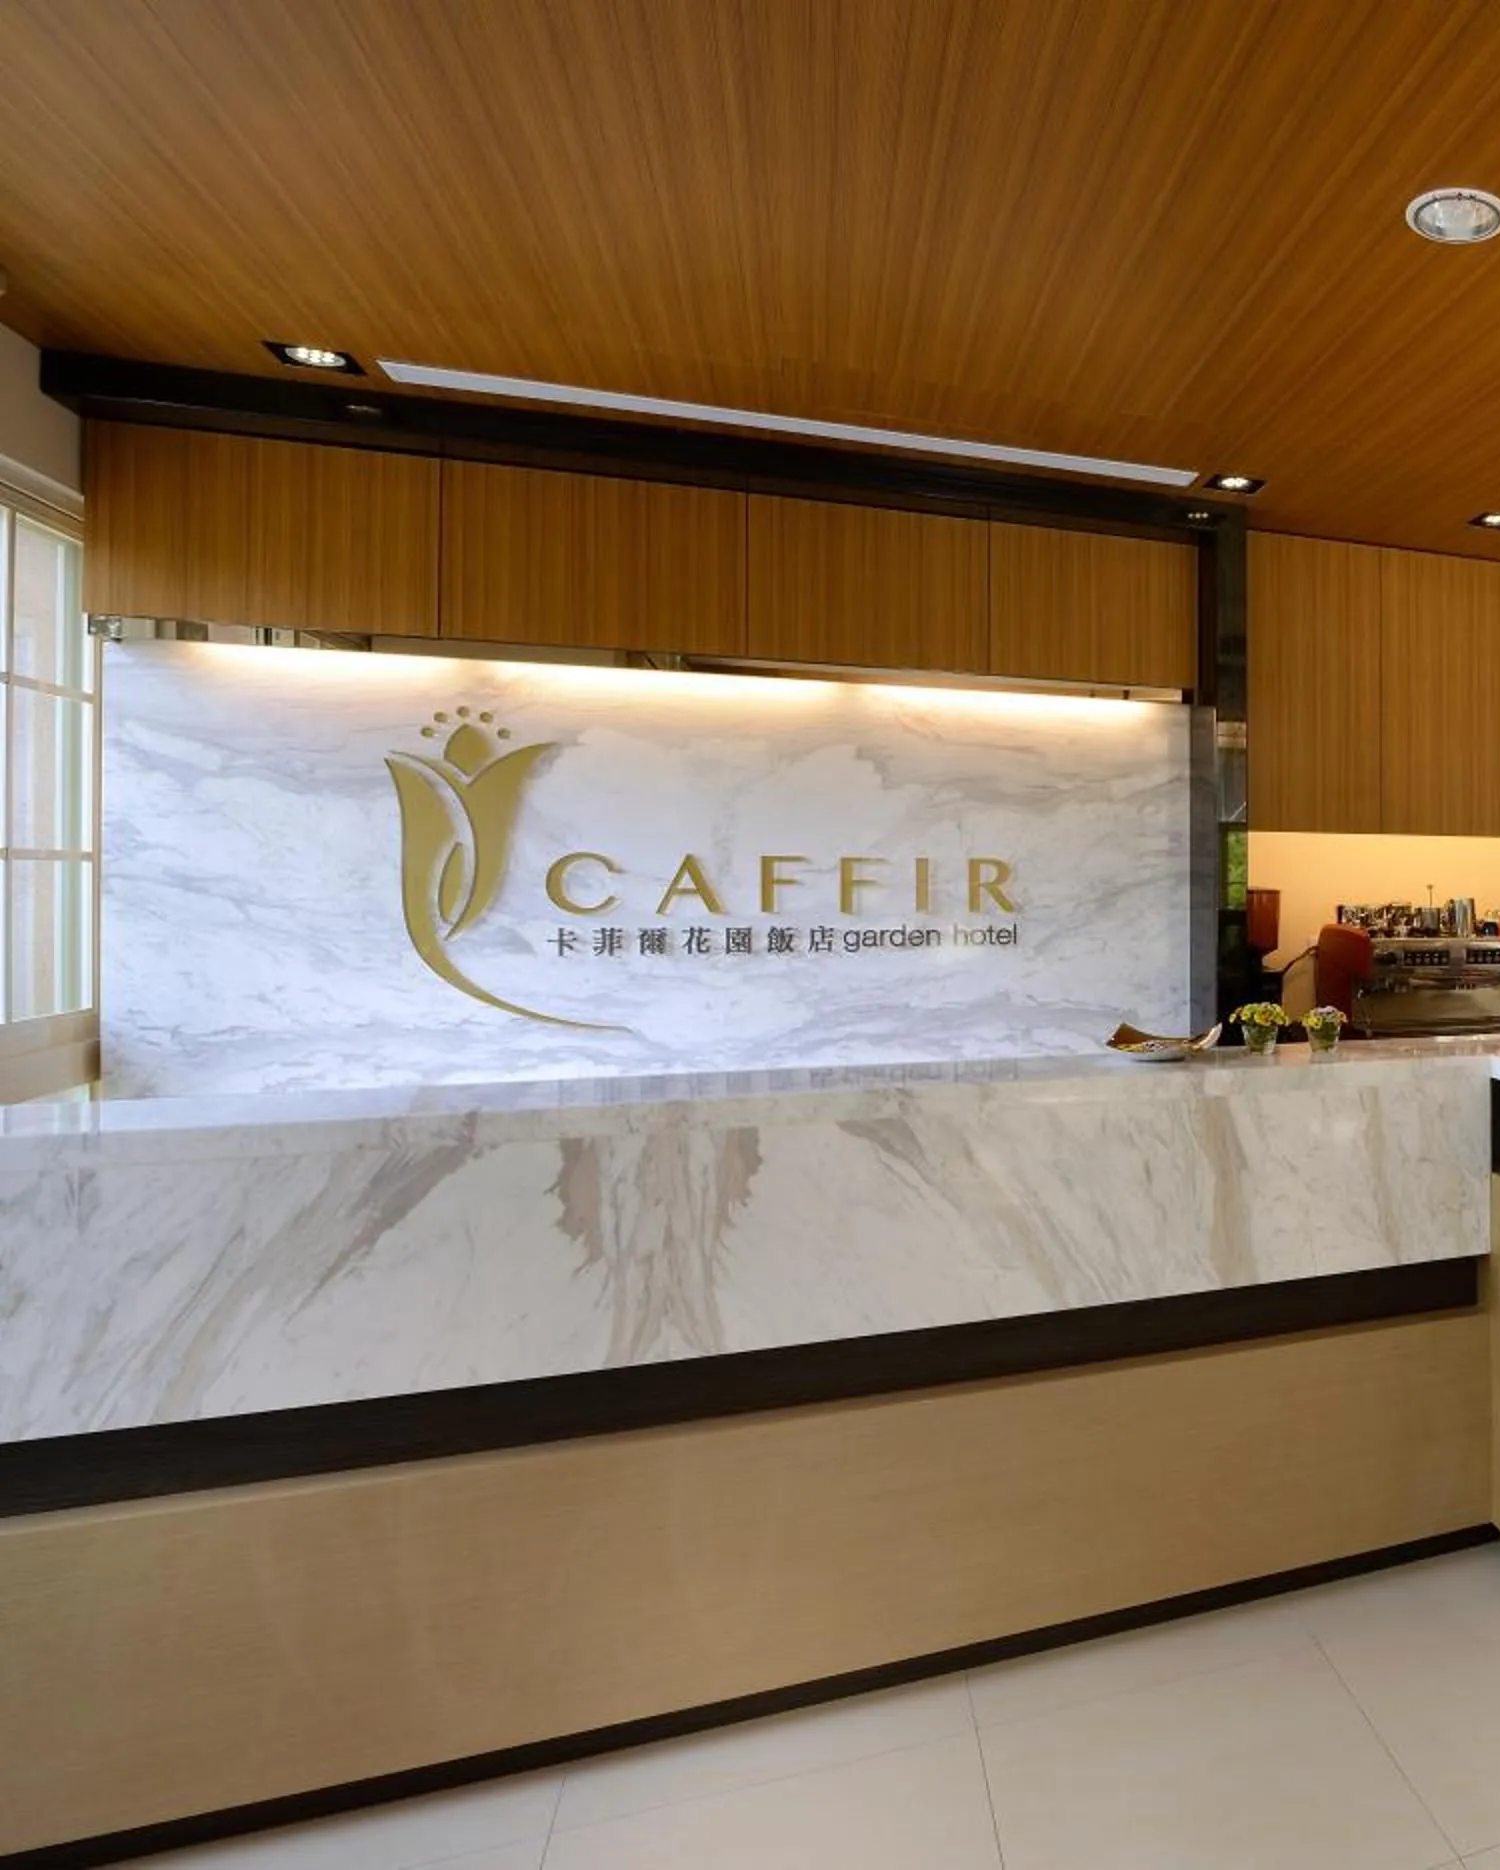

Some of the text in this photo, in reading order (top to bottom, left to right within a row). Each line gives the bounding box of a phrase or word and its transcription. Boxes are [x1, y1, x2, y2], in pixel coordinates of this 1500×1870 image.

[545, 851, 1015, 916] CAFFIR
[547, 923, 1018, 957] 卡菲爾花園飯店 garden hotel
